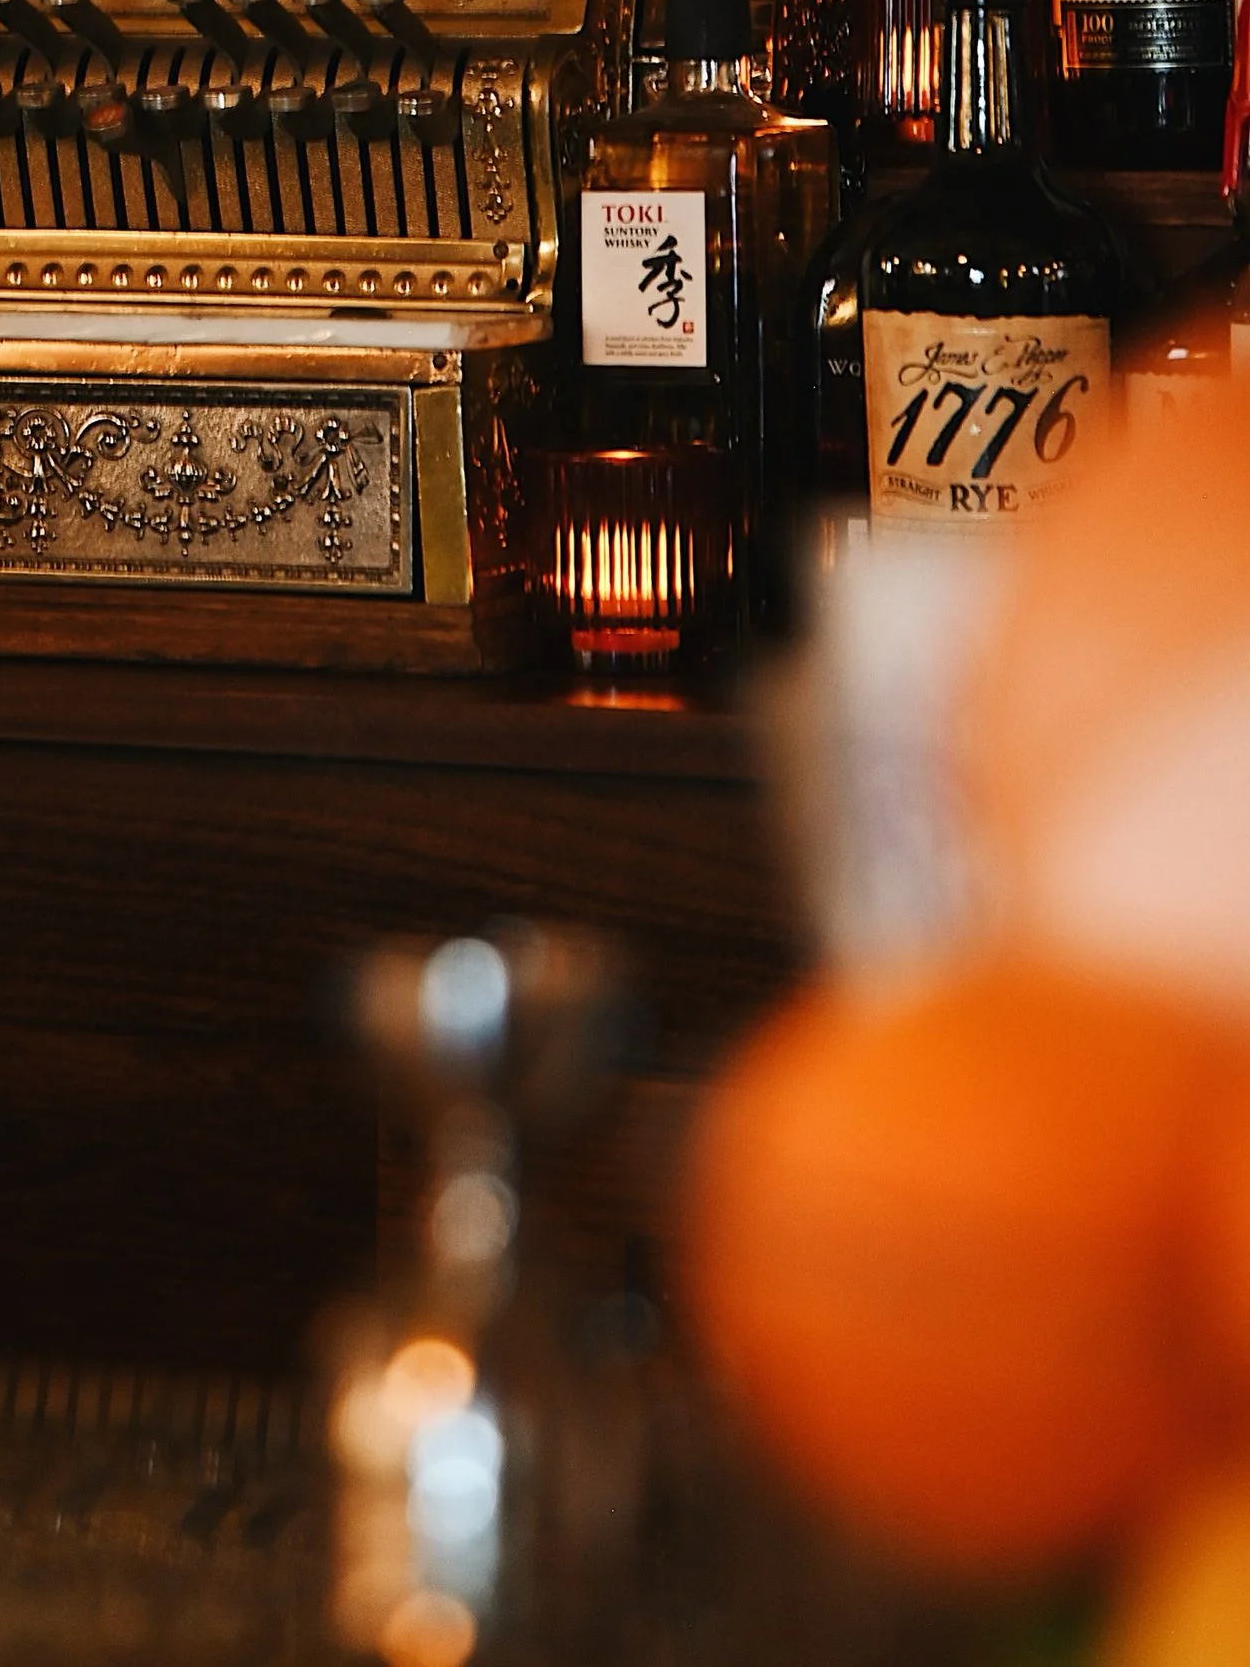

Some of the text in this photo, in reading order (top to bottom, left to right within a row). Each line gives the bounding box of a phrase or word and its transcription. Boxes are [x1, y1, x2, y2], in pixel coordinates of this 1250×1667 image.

[1081, 12, 1115, 34] 100
[601, 205, 664, 224] TOKI
[603, 227, 659, 237] SUNTORY
[604, 238, 652, 248] WHISKY
[886, 374, 1089, 480] 1776
[886, 475, 943, 503] STRAIGHT
[950, 482, 1020, 513] RYE
